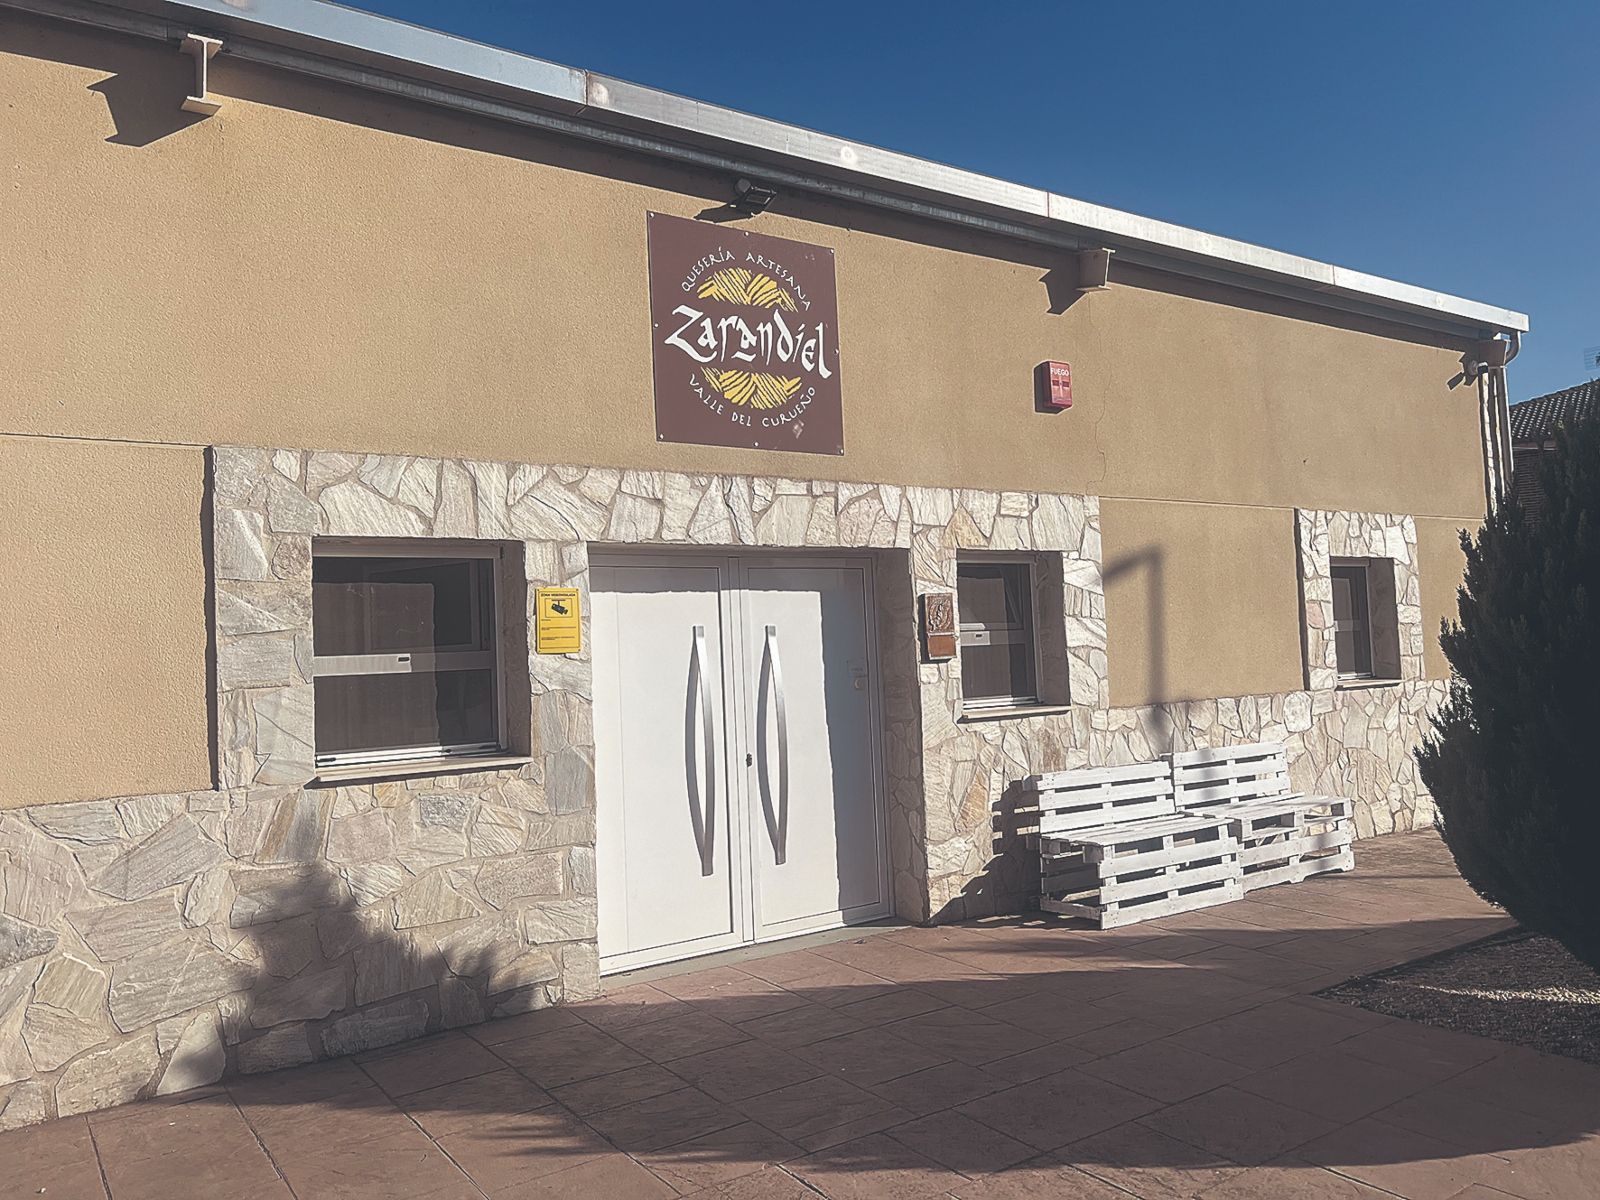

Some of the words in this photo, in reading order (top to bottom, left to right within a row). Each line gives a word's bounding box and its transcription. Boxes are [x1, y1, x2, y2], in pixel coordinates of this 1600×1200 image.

[682, 246, 735, 292] QUESERÍA
[745, 252, 811, 311] ARTESANA
[1050, 368, 1069, 376] FUEGO
[689, 374, 724, 415] VALLE
[732, 411, 751, 427] DEL
[761, 387, 815, 427] CURUEÑO
